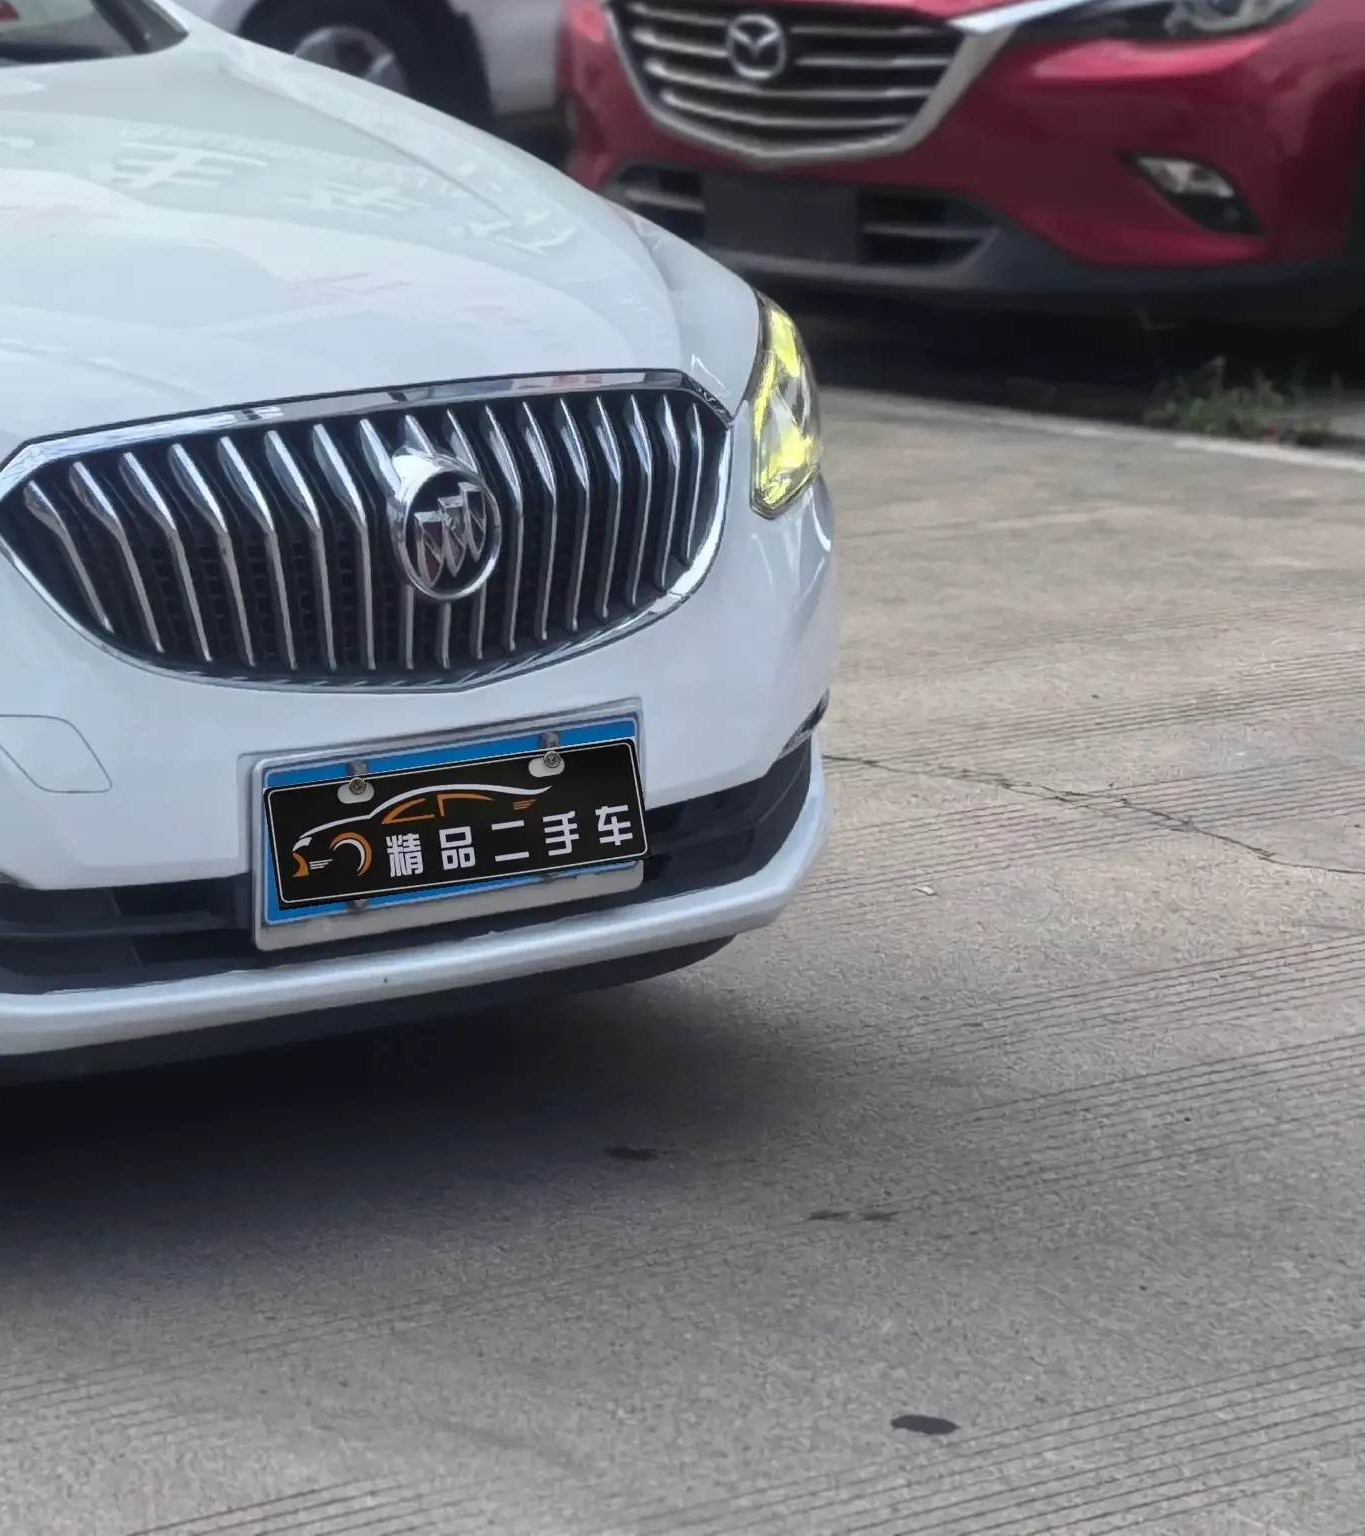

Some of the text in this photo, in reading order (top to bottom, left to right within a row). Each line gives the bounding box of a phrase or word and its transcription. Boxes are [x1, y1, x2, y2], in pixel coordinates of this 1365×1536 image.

[386, 804, 633, 877] 精品二手车
